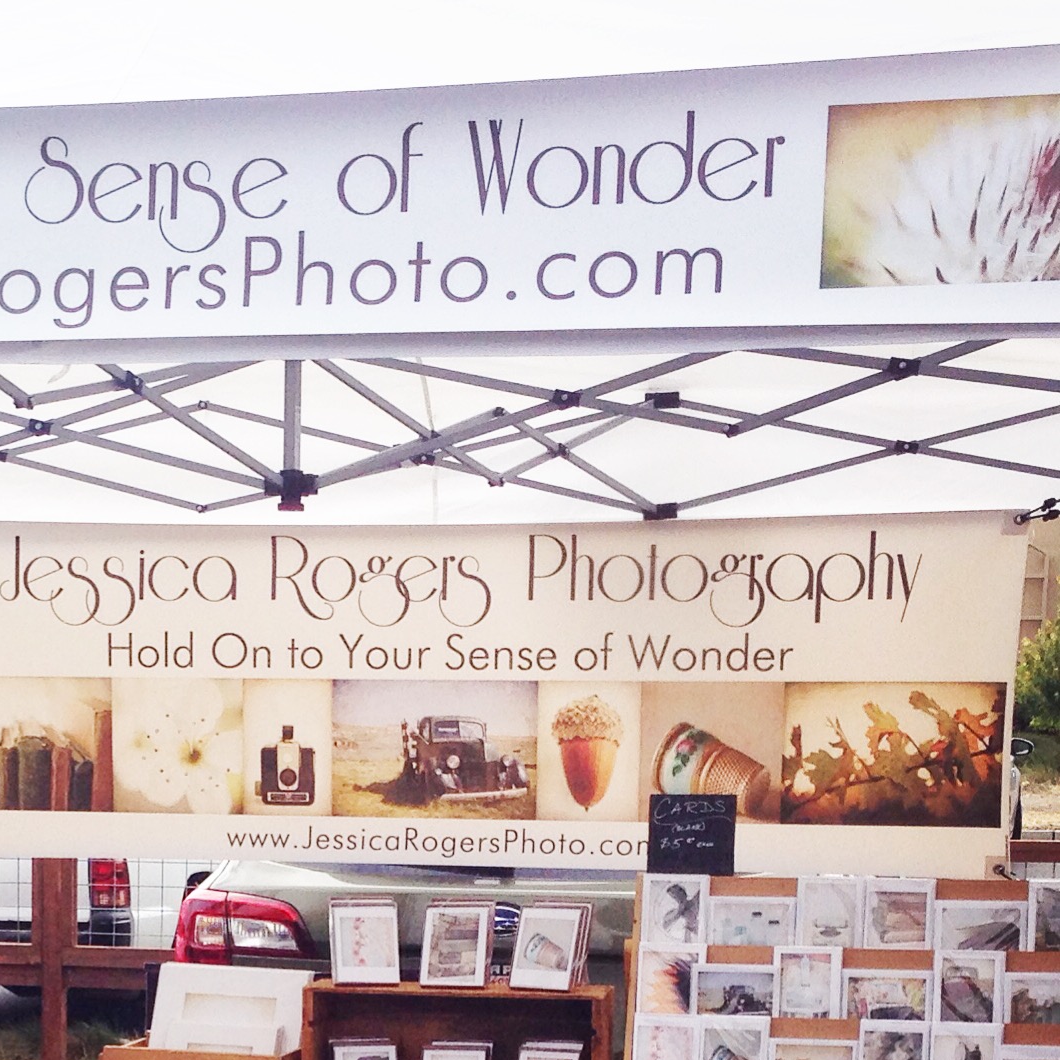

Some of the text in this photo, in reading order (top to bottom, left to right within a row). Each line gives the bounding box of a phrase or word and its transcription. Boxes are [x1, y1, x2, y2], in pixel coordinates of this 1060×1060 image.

[25, 135, 288, 253] Sense
[337, 121, 423, 216] of
[468, 110, 785, 216] Wonder
[0, 531, 922, 628] Jessica Rogers Photography
[108, 631, 794, 672] Hold On to Your Sense of Wonder
[654, 798, 726, 819] CARDS
